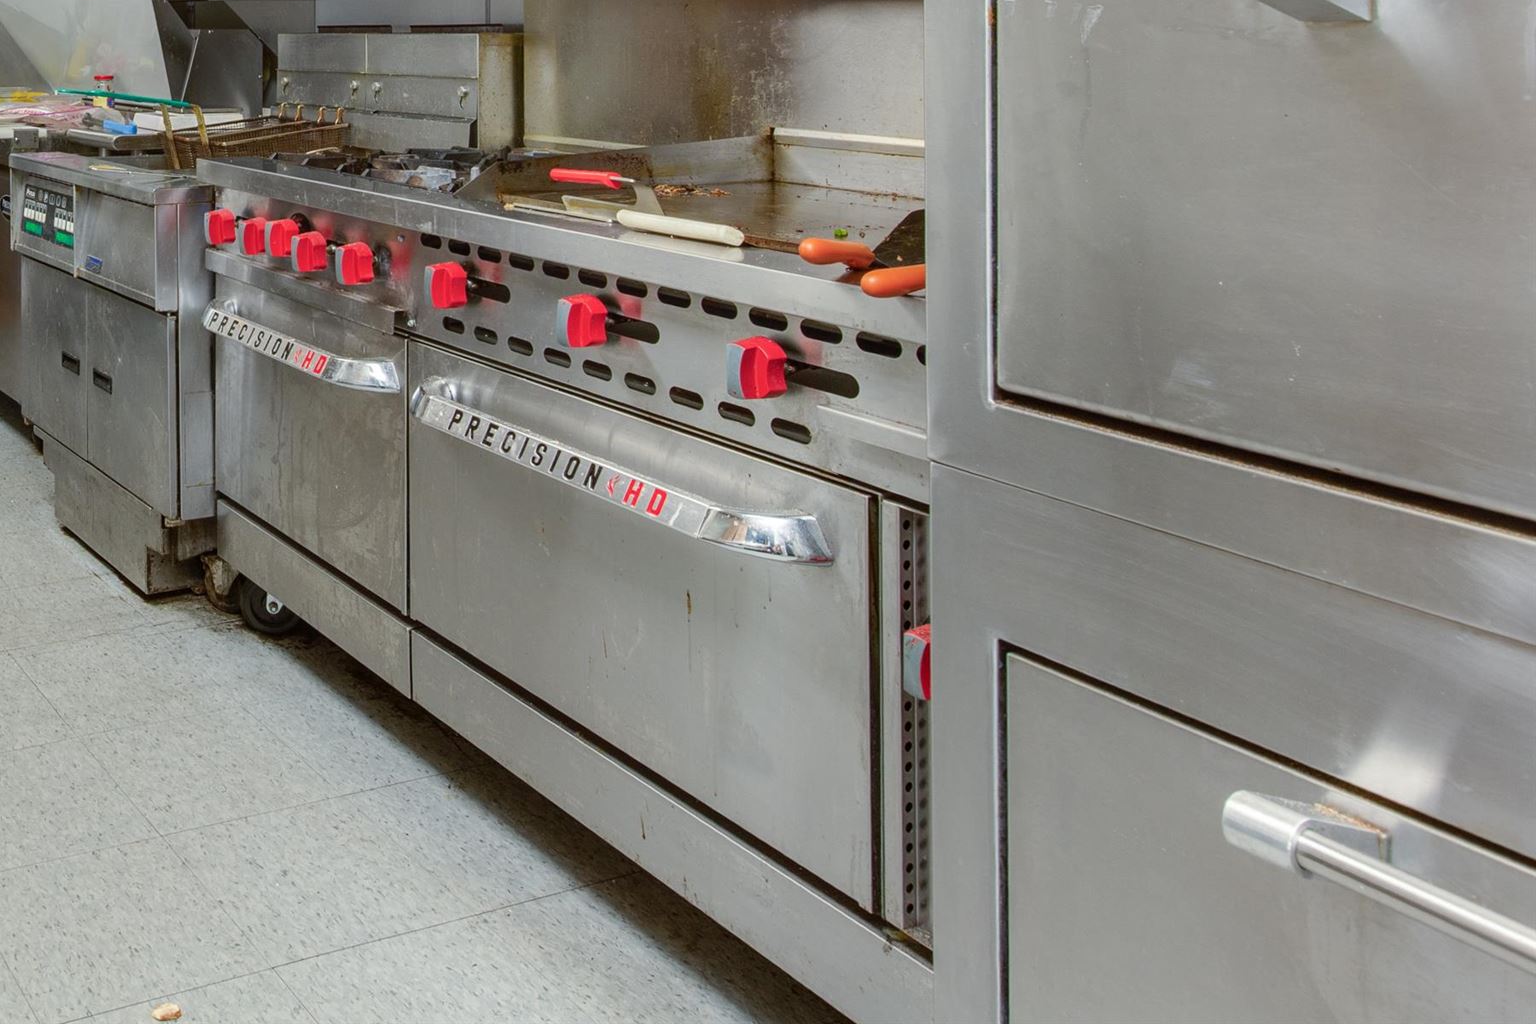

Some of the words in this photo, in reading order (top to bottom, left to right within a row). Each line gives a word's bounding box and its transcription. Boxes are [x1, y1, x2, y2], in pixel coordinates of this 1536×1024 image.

[210, 312, 294, 360] PRECISION
[301, 351, 328, 375] HD
[448, 408, 603, 490] PRECISION
[622, 479, 668, 517] HD
